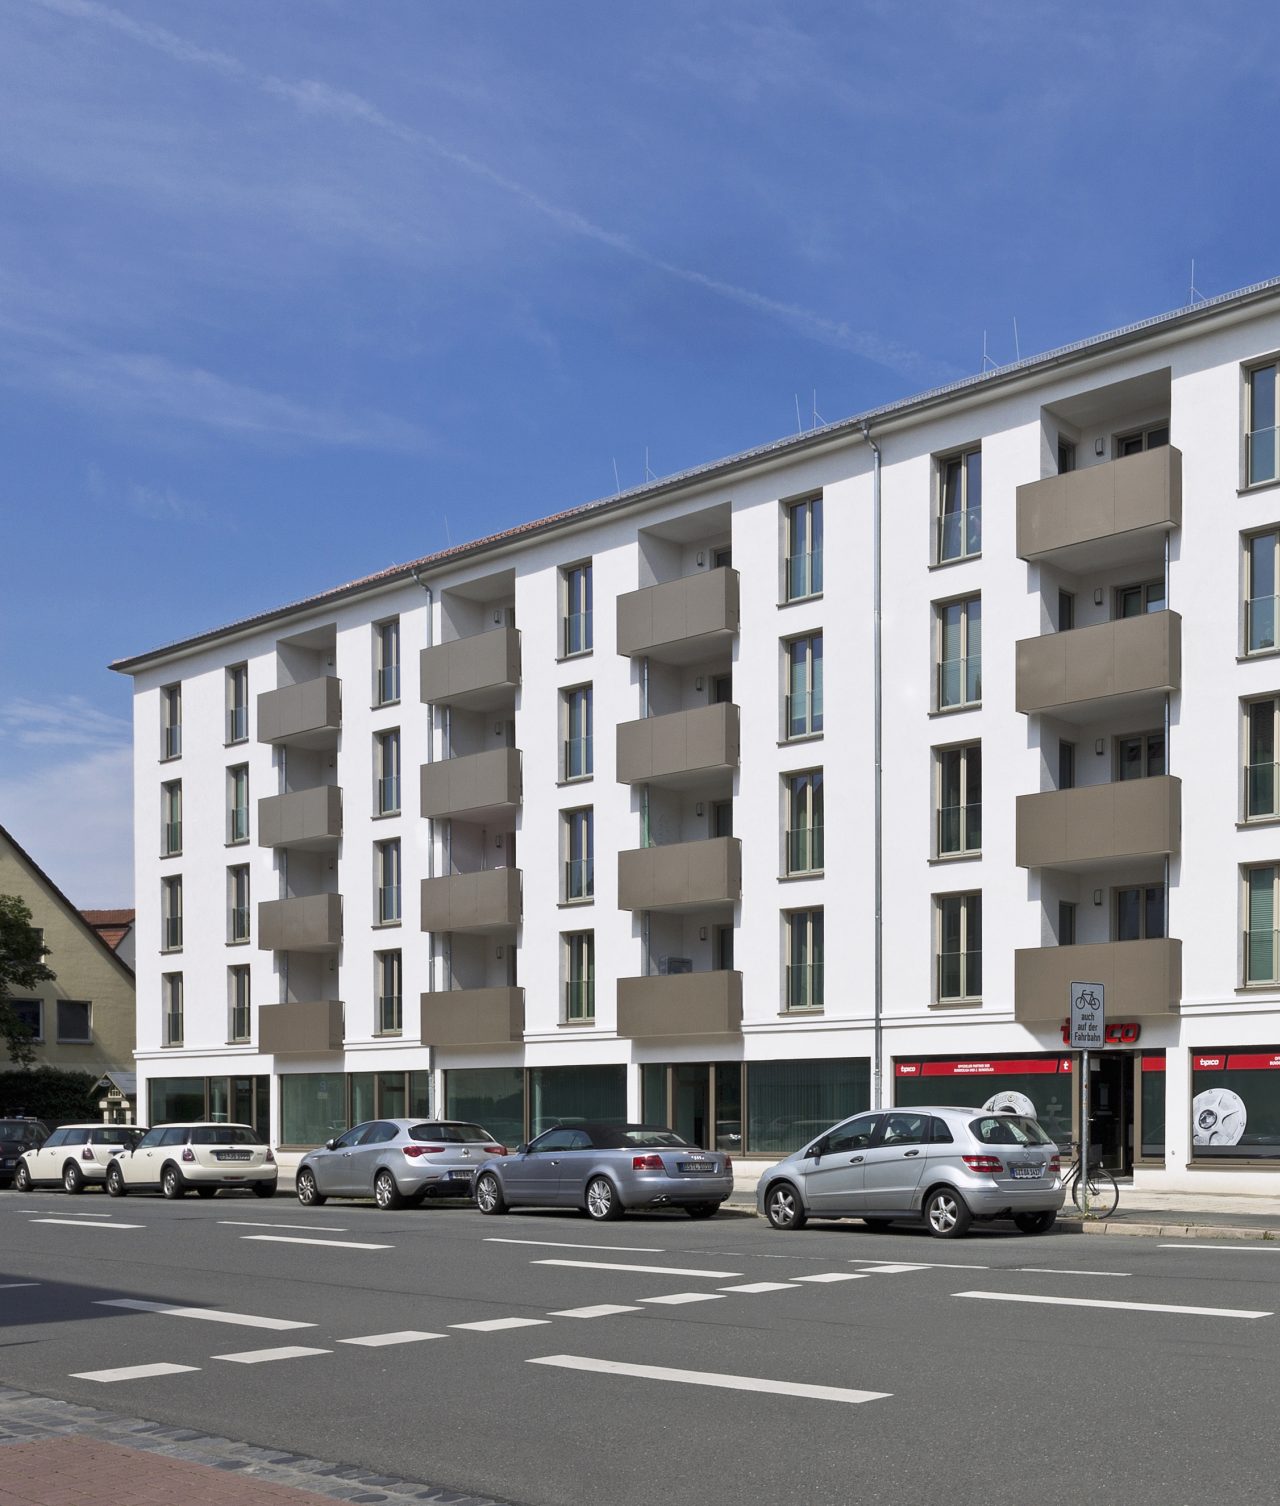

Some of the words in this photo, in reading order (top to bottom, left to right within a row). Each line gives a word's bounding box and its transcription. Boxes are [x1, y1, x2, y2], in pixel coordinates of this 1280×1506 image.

[1081, 1013, 1095, 1021] auch
[1061, 1017, 1141, 1046] tco
[1077, 1023, 1087, 1032] auf
[1088, 1023, 1098, 1032] der
[1074, 1032, 1101, 1042] Fahrbahn
